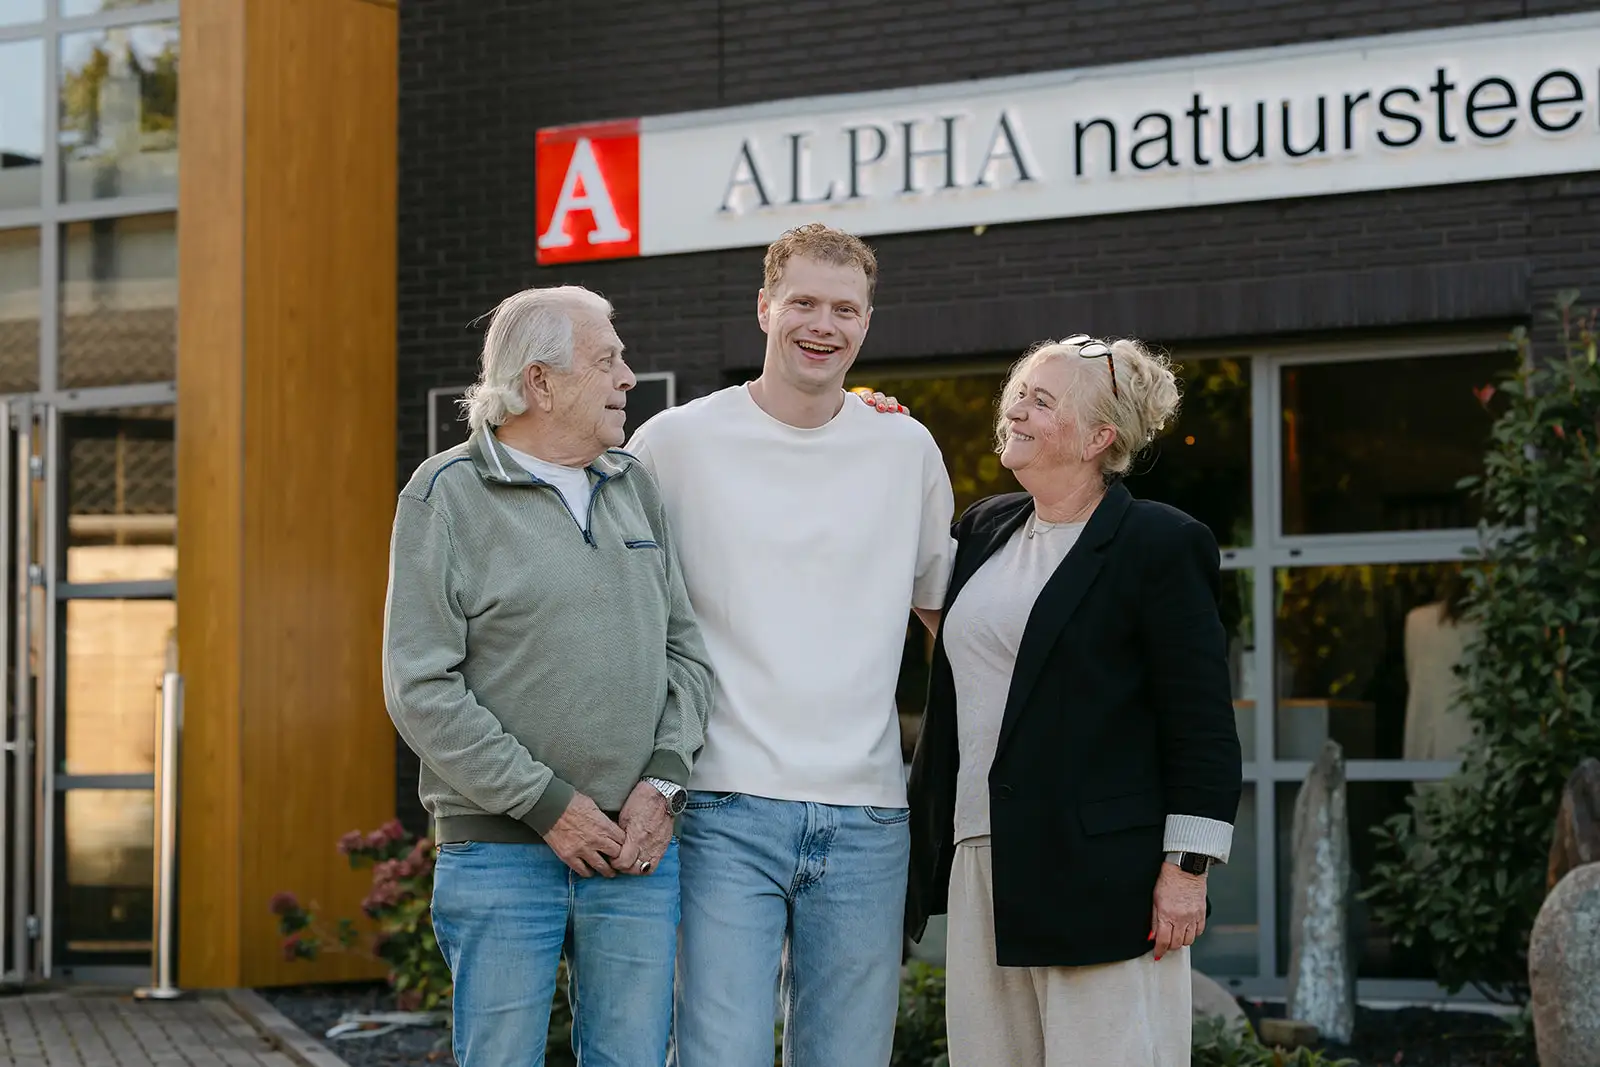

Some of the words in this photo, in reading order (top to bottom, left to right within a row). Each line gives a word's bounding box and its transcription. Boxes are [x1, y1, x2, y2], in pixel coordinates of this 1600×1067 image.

[538, 137, 631, 248] A
[718, 109, 1038, 212] ALPHA
[1073, 67, 1600, 176] natuurstee
